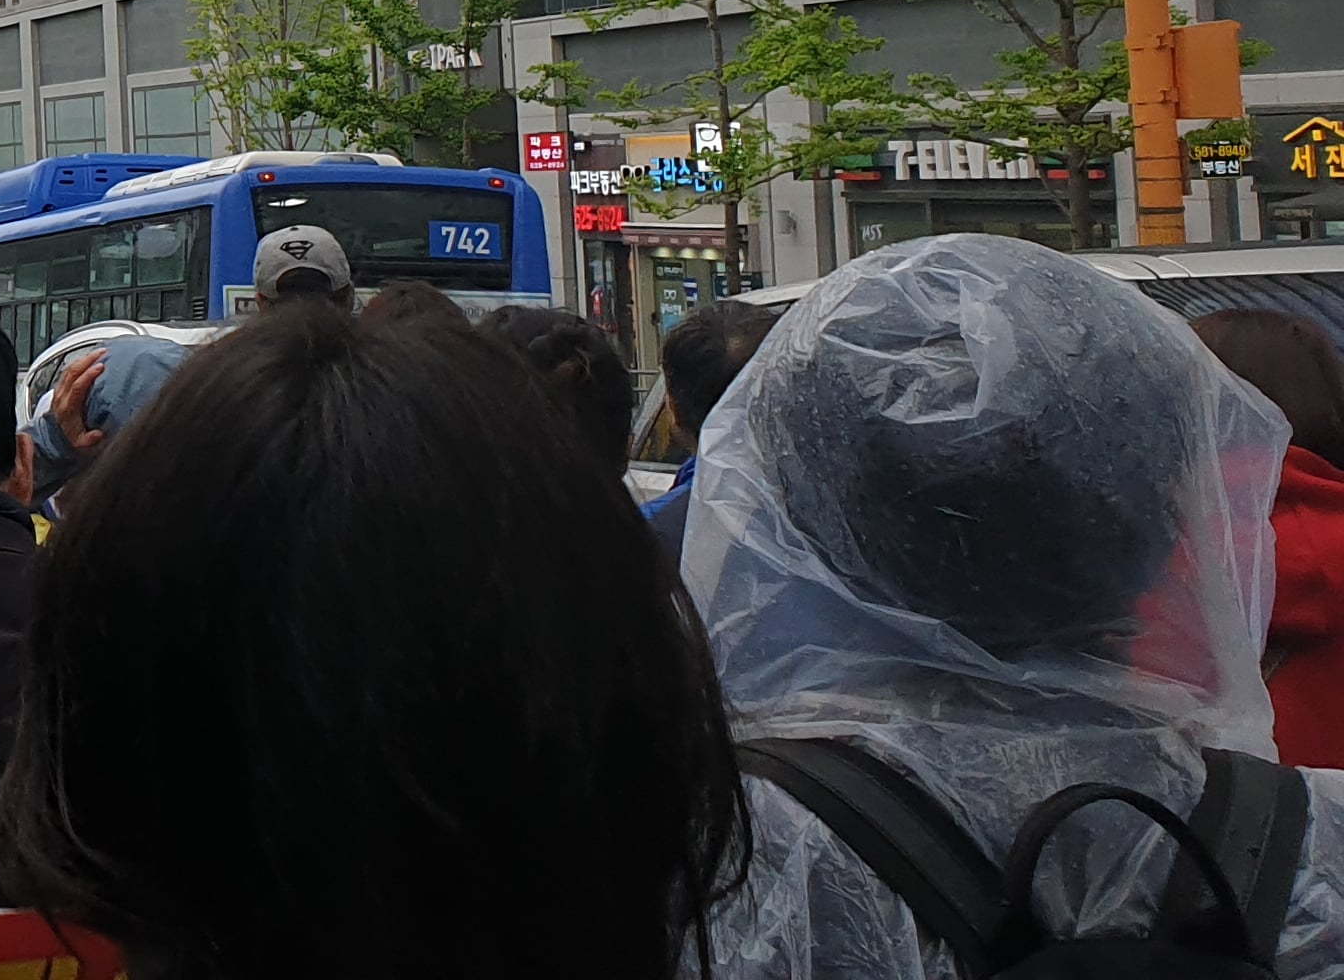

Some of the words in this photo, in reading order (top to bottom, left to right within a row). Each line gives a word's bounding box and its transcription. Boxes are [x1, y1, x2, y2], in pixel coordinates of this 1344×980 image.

[531, 149, 563, 159] 부동산
[1202, 160, 1240, 174] 부동산
[570, 170, 622, 195] 파크부동산
[440, 226, 491, 254] 742
